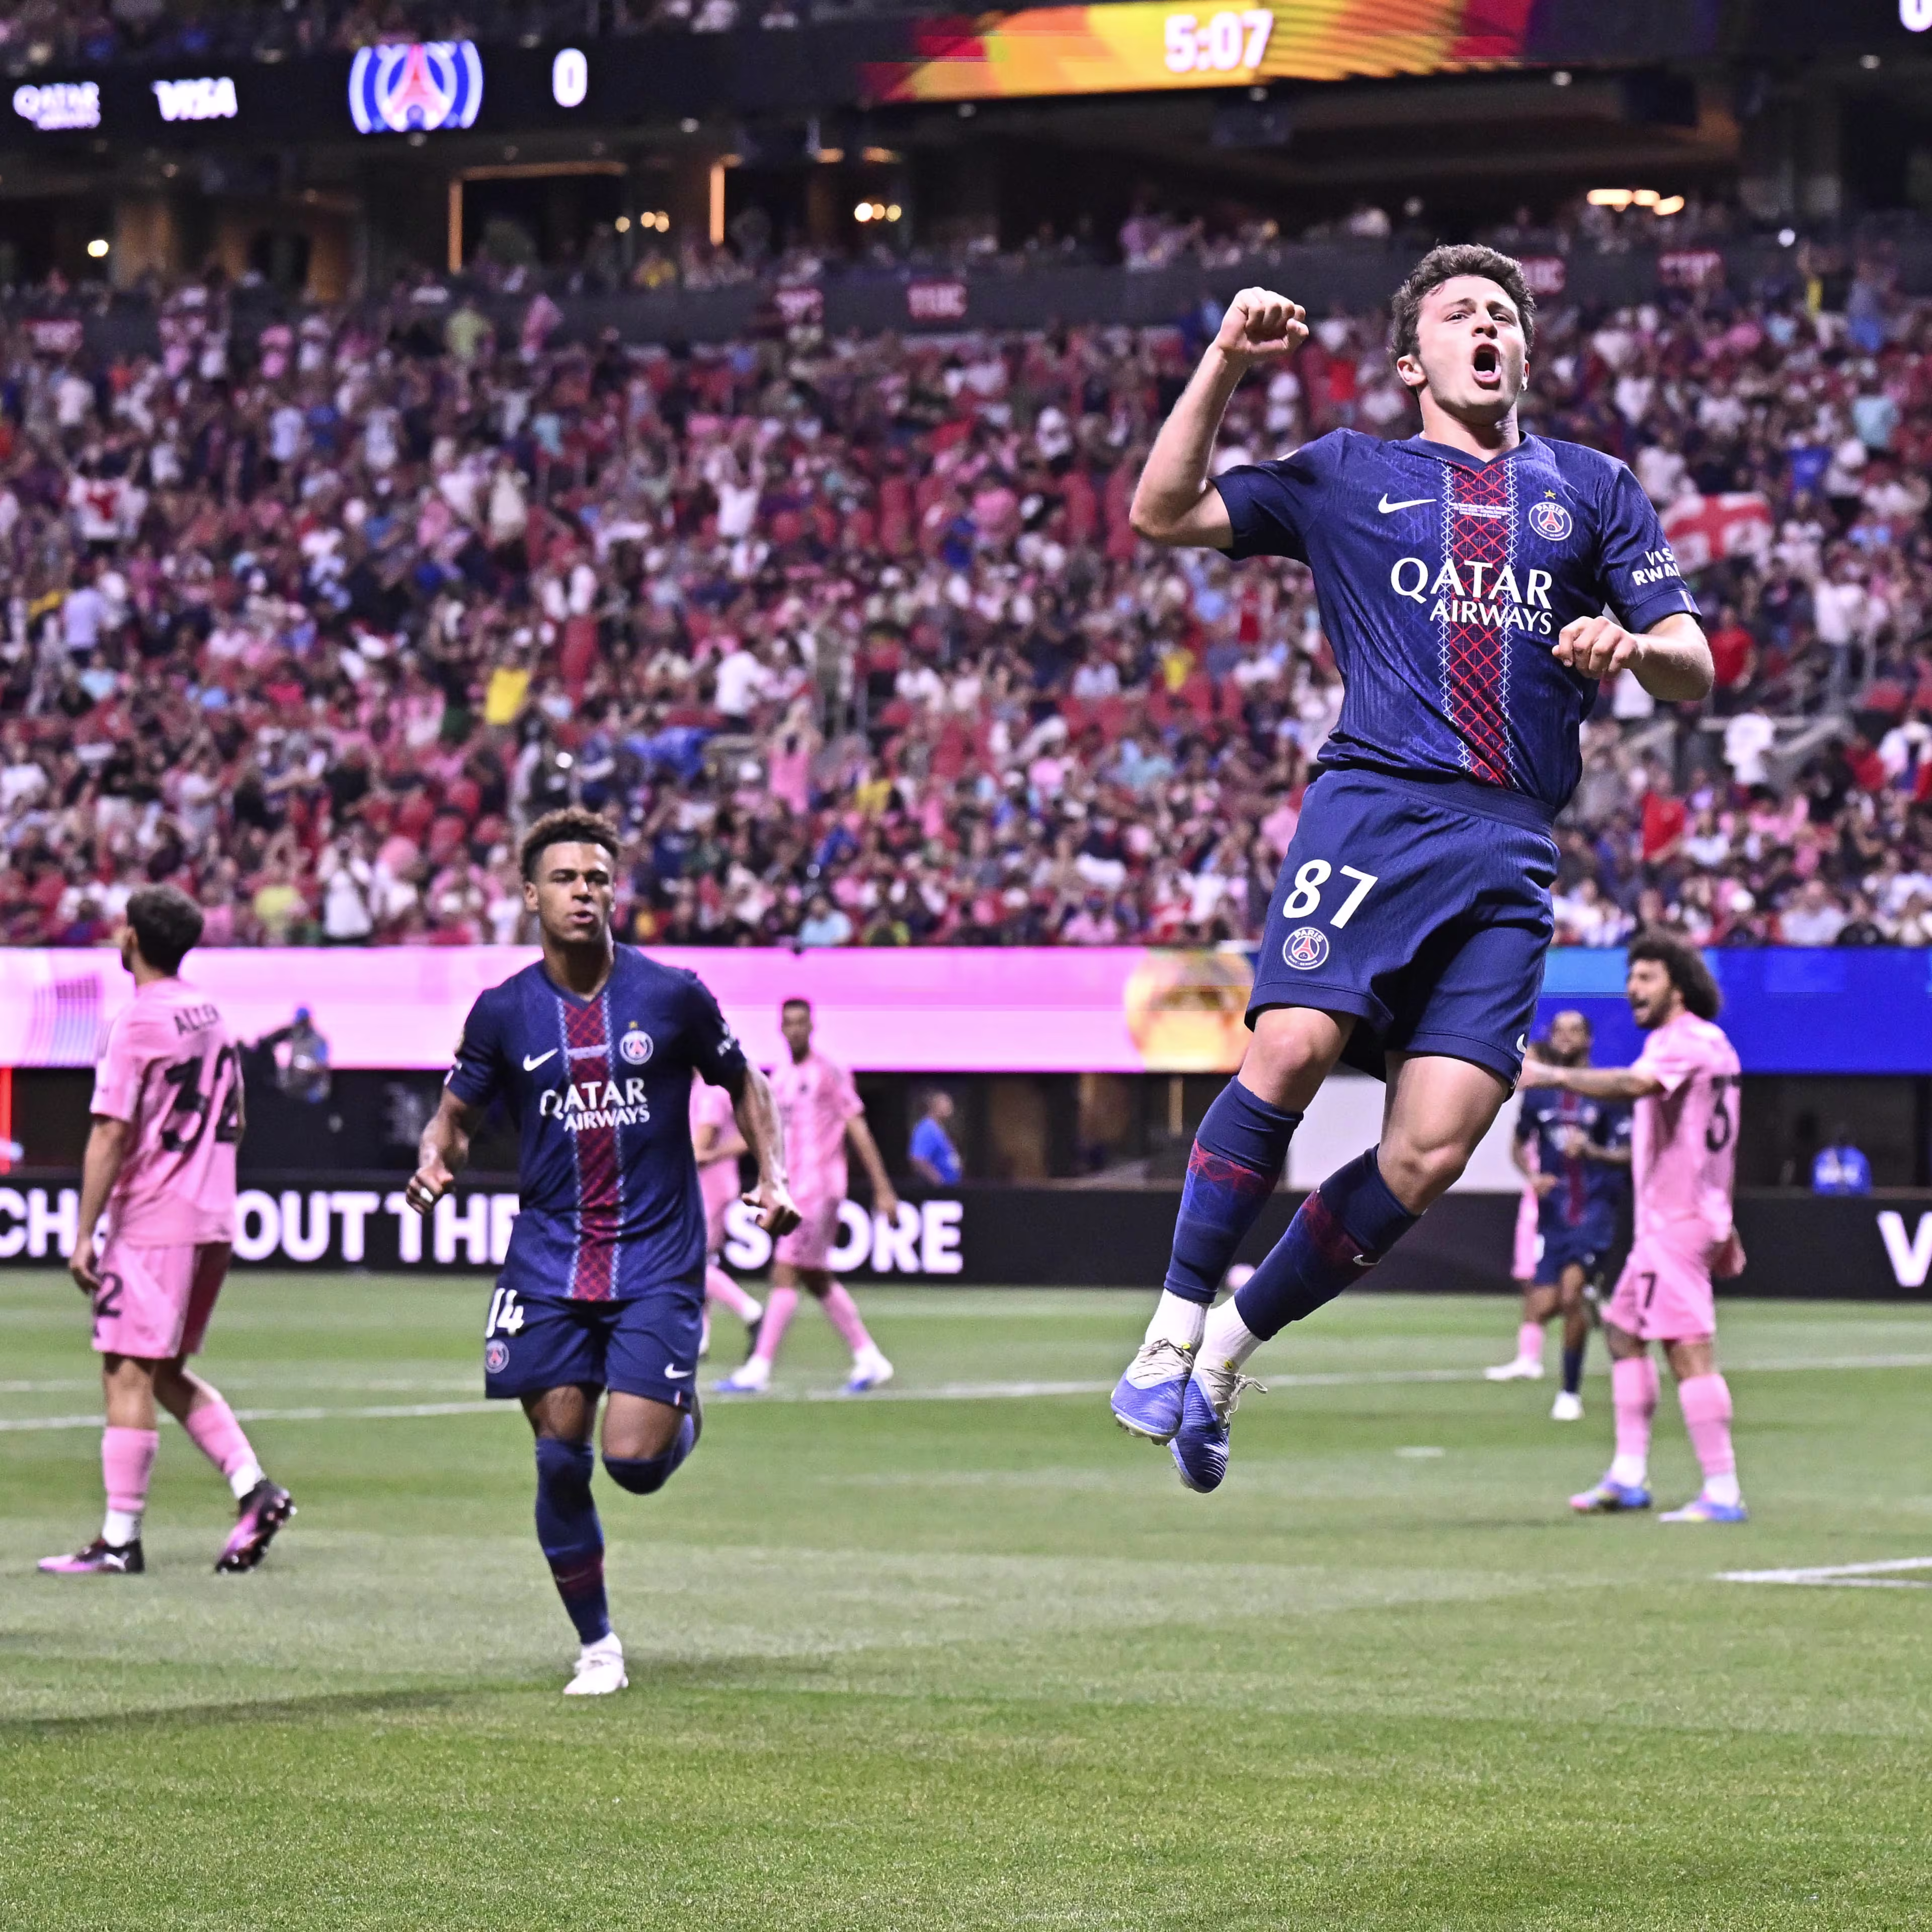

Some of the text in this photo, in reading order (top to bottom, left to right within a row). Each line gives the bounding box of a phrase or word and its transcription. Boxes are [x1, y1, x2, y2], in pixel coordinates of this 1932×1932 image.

[1165, 9, 1273, 72] 5:07
[552, 48, 588, 107] 0
[1536, 504, 1565, 516] PARIS
[1391, 557, 1552, 609] QATAR
[1429, 599, 1552, 634] AIRWAYS
[1282, 859, 1378, 929] 87
[1294, 929, 1324, 943] PARIS
[540, 1077, 648, 1120] QATAR
[564, 1104, 651, 1132] AIRWAYS
[232, 1189, 380, 1262] OUT
[724, 1199, 963, 1273] SORE
[486, 1287, 524, 1338] 14
[1640, 1271, 1658, 1308] 7
